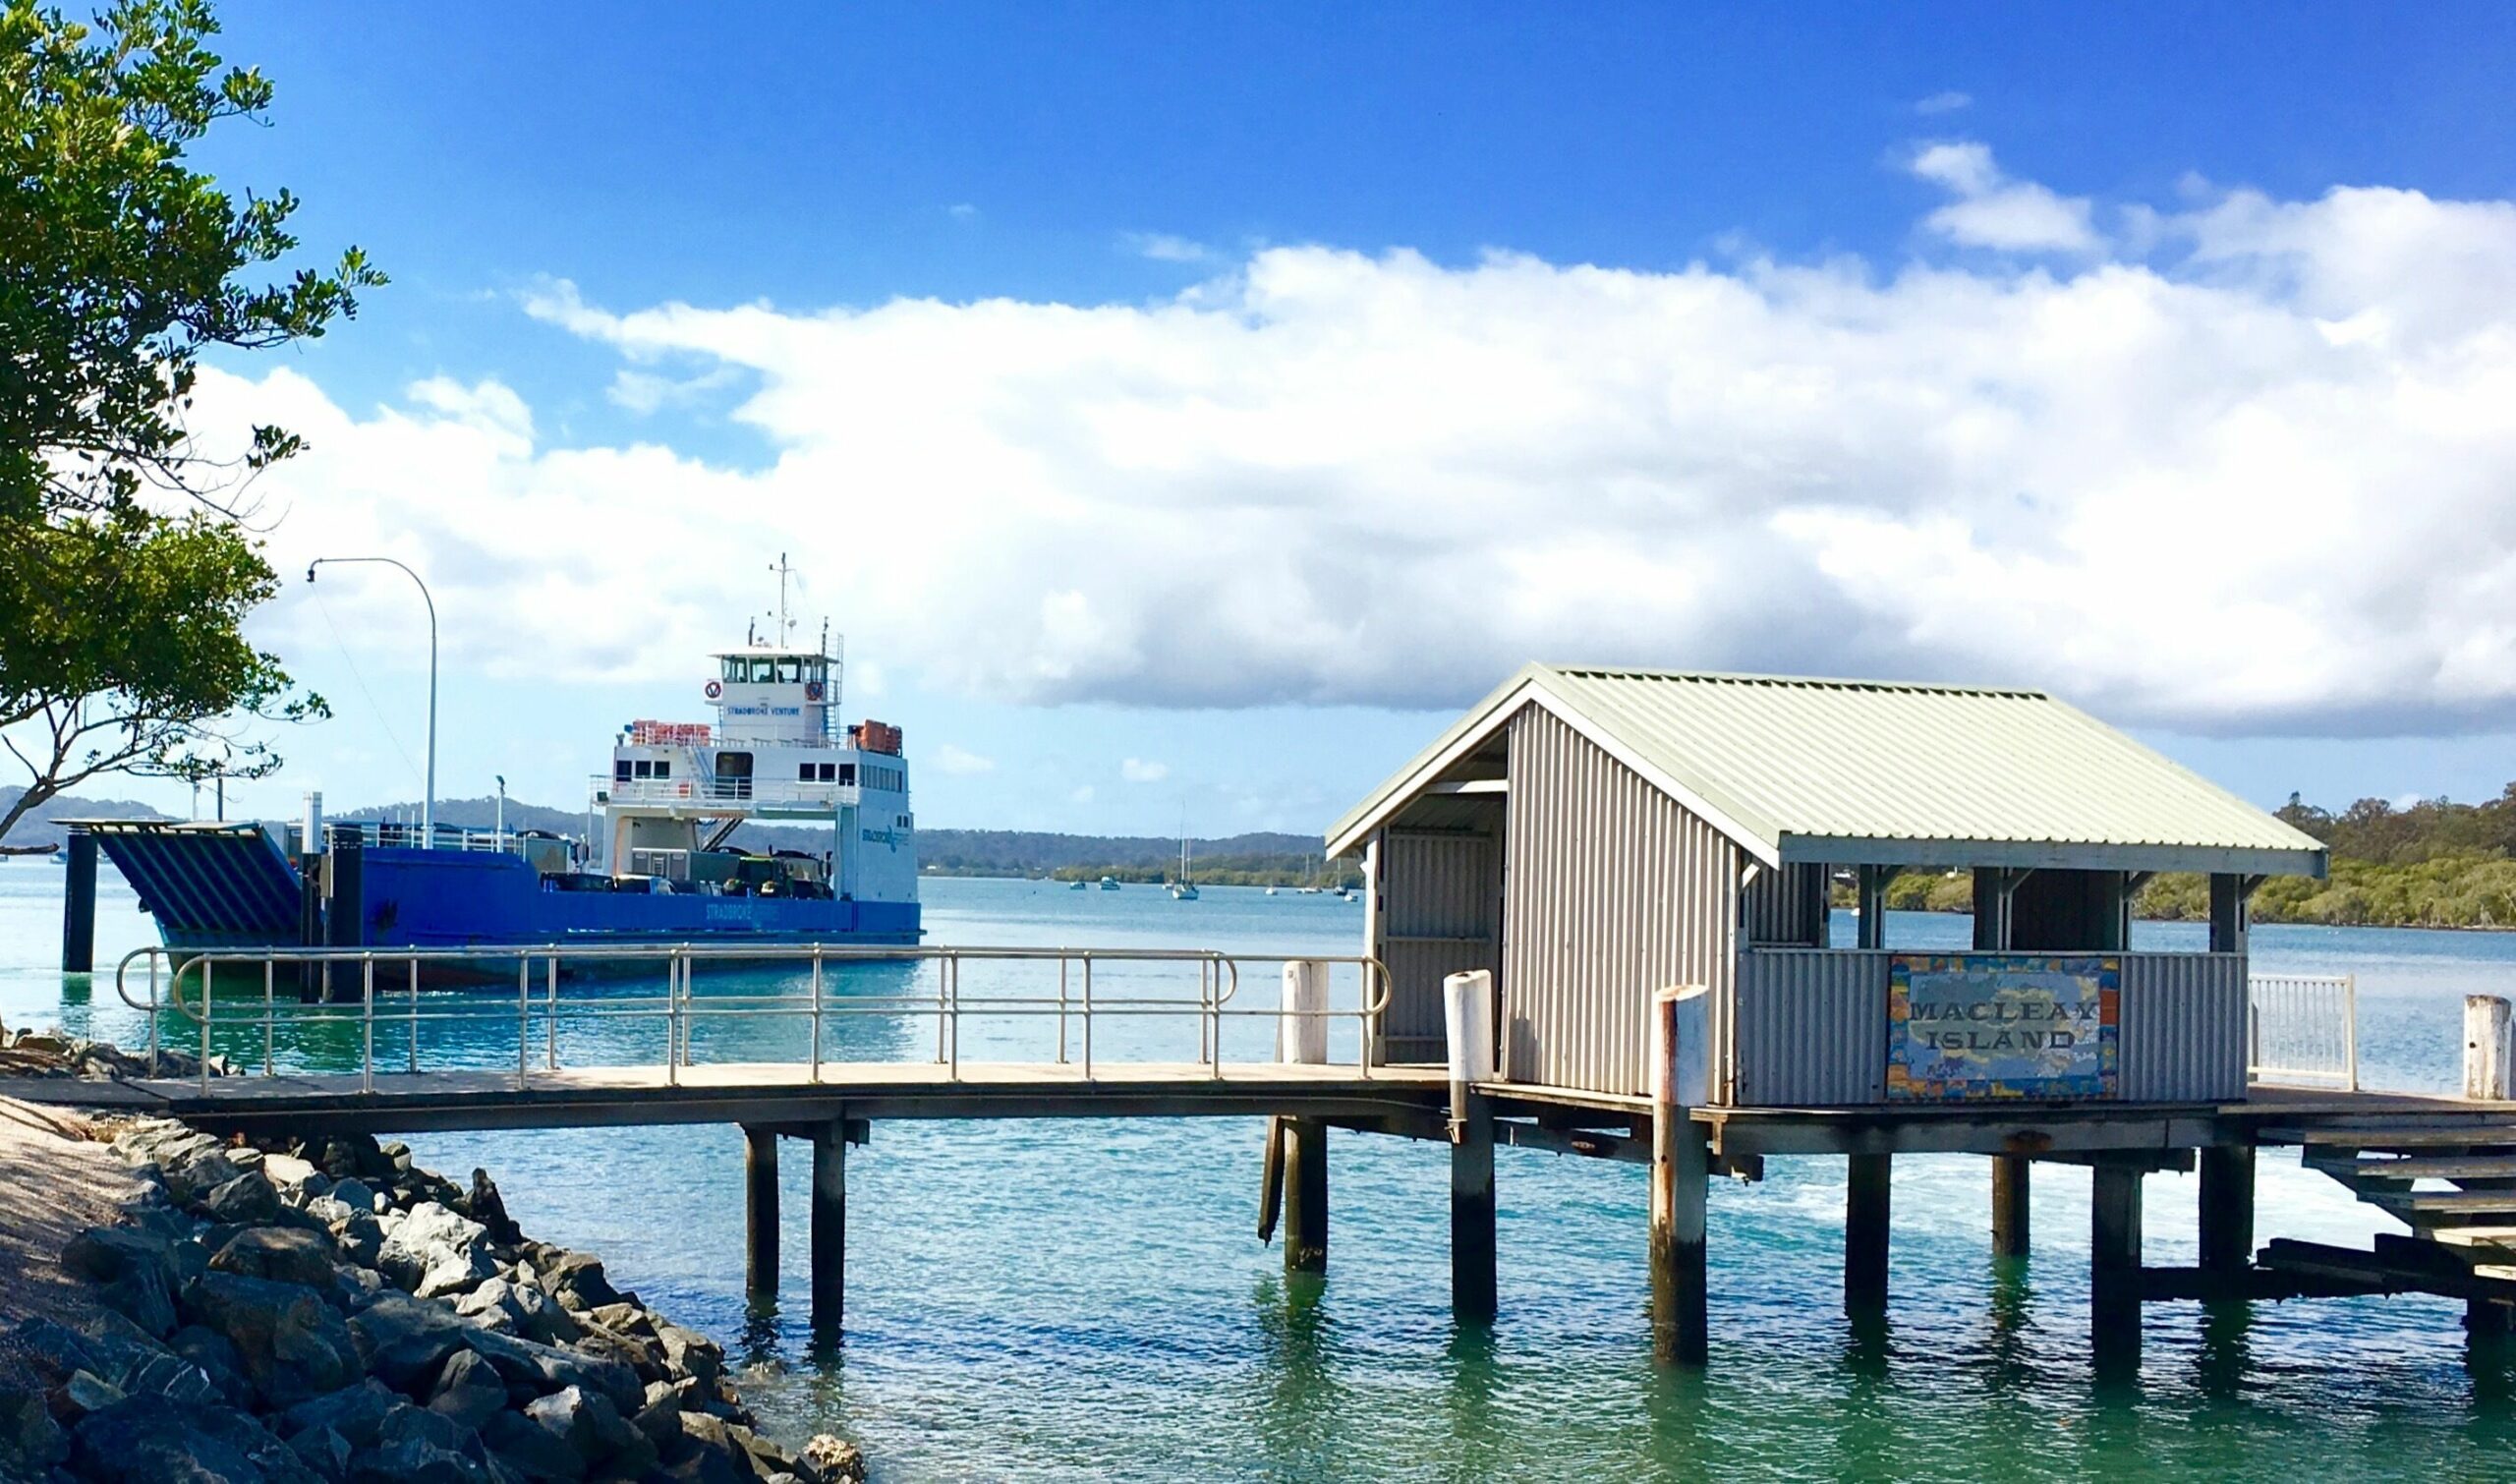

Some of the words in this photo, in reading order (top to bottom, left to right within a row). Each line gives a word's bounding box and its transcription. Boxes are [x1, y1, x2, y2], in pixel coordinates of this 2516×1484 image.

[771, 707, 800, 715] VENTURE
[1910, 1001, 2098, 1021] MACLEAY
[1925, 1031, 2075, 1050] ISLAND
